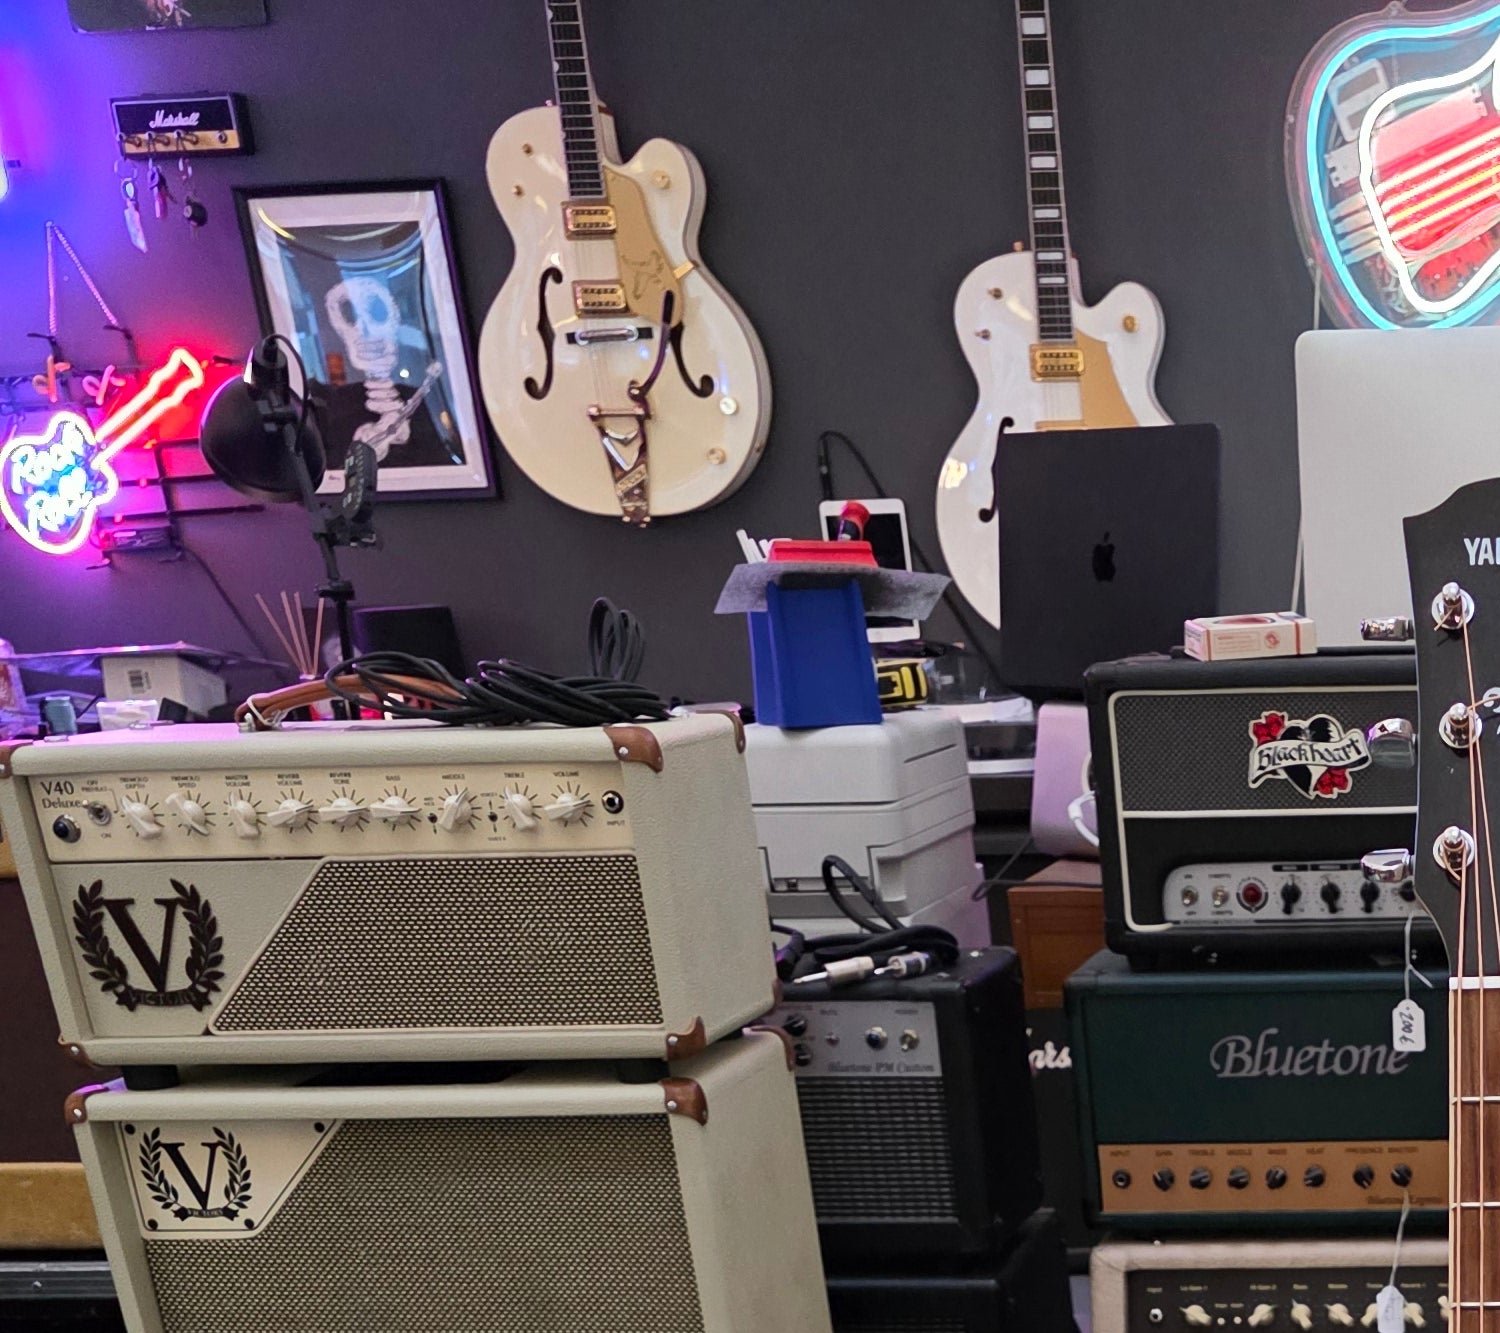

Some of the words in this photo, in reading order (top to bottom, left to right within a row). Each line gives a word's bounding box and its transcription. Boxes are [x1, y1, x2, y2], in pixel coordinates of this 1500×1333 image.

[149, 109, 200, 128] Marshall
[41, 781, 75, 796] V40
[41, 797, 81, 809] Deluxe
[103, 897, 178, 993] V
[1209, 1028, 1409, 1078] Bluetone
[160, 1142, 220, 1211] V
